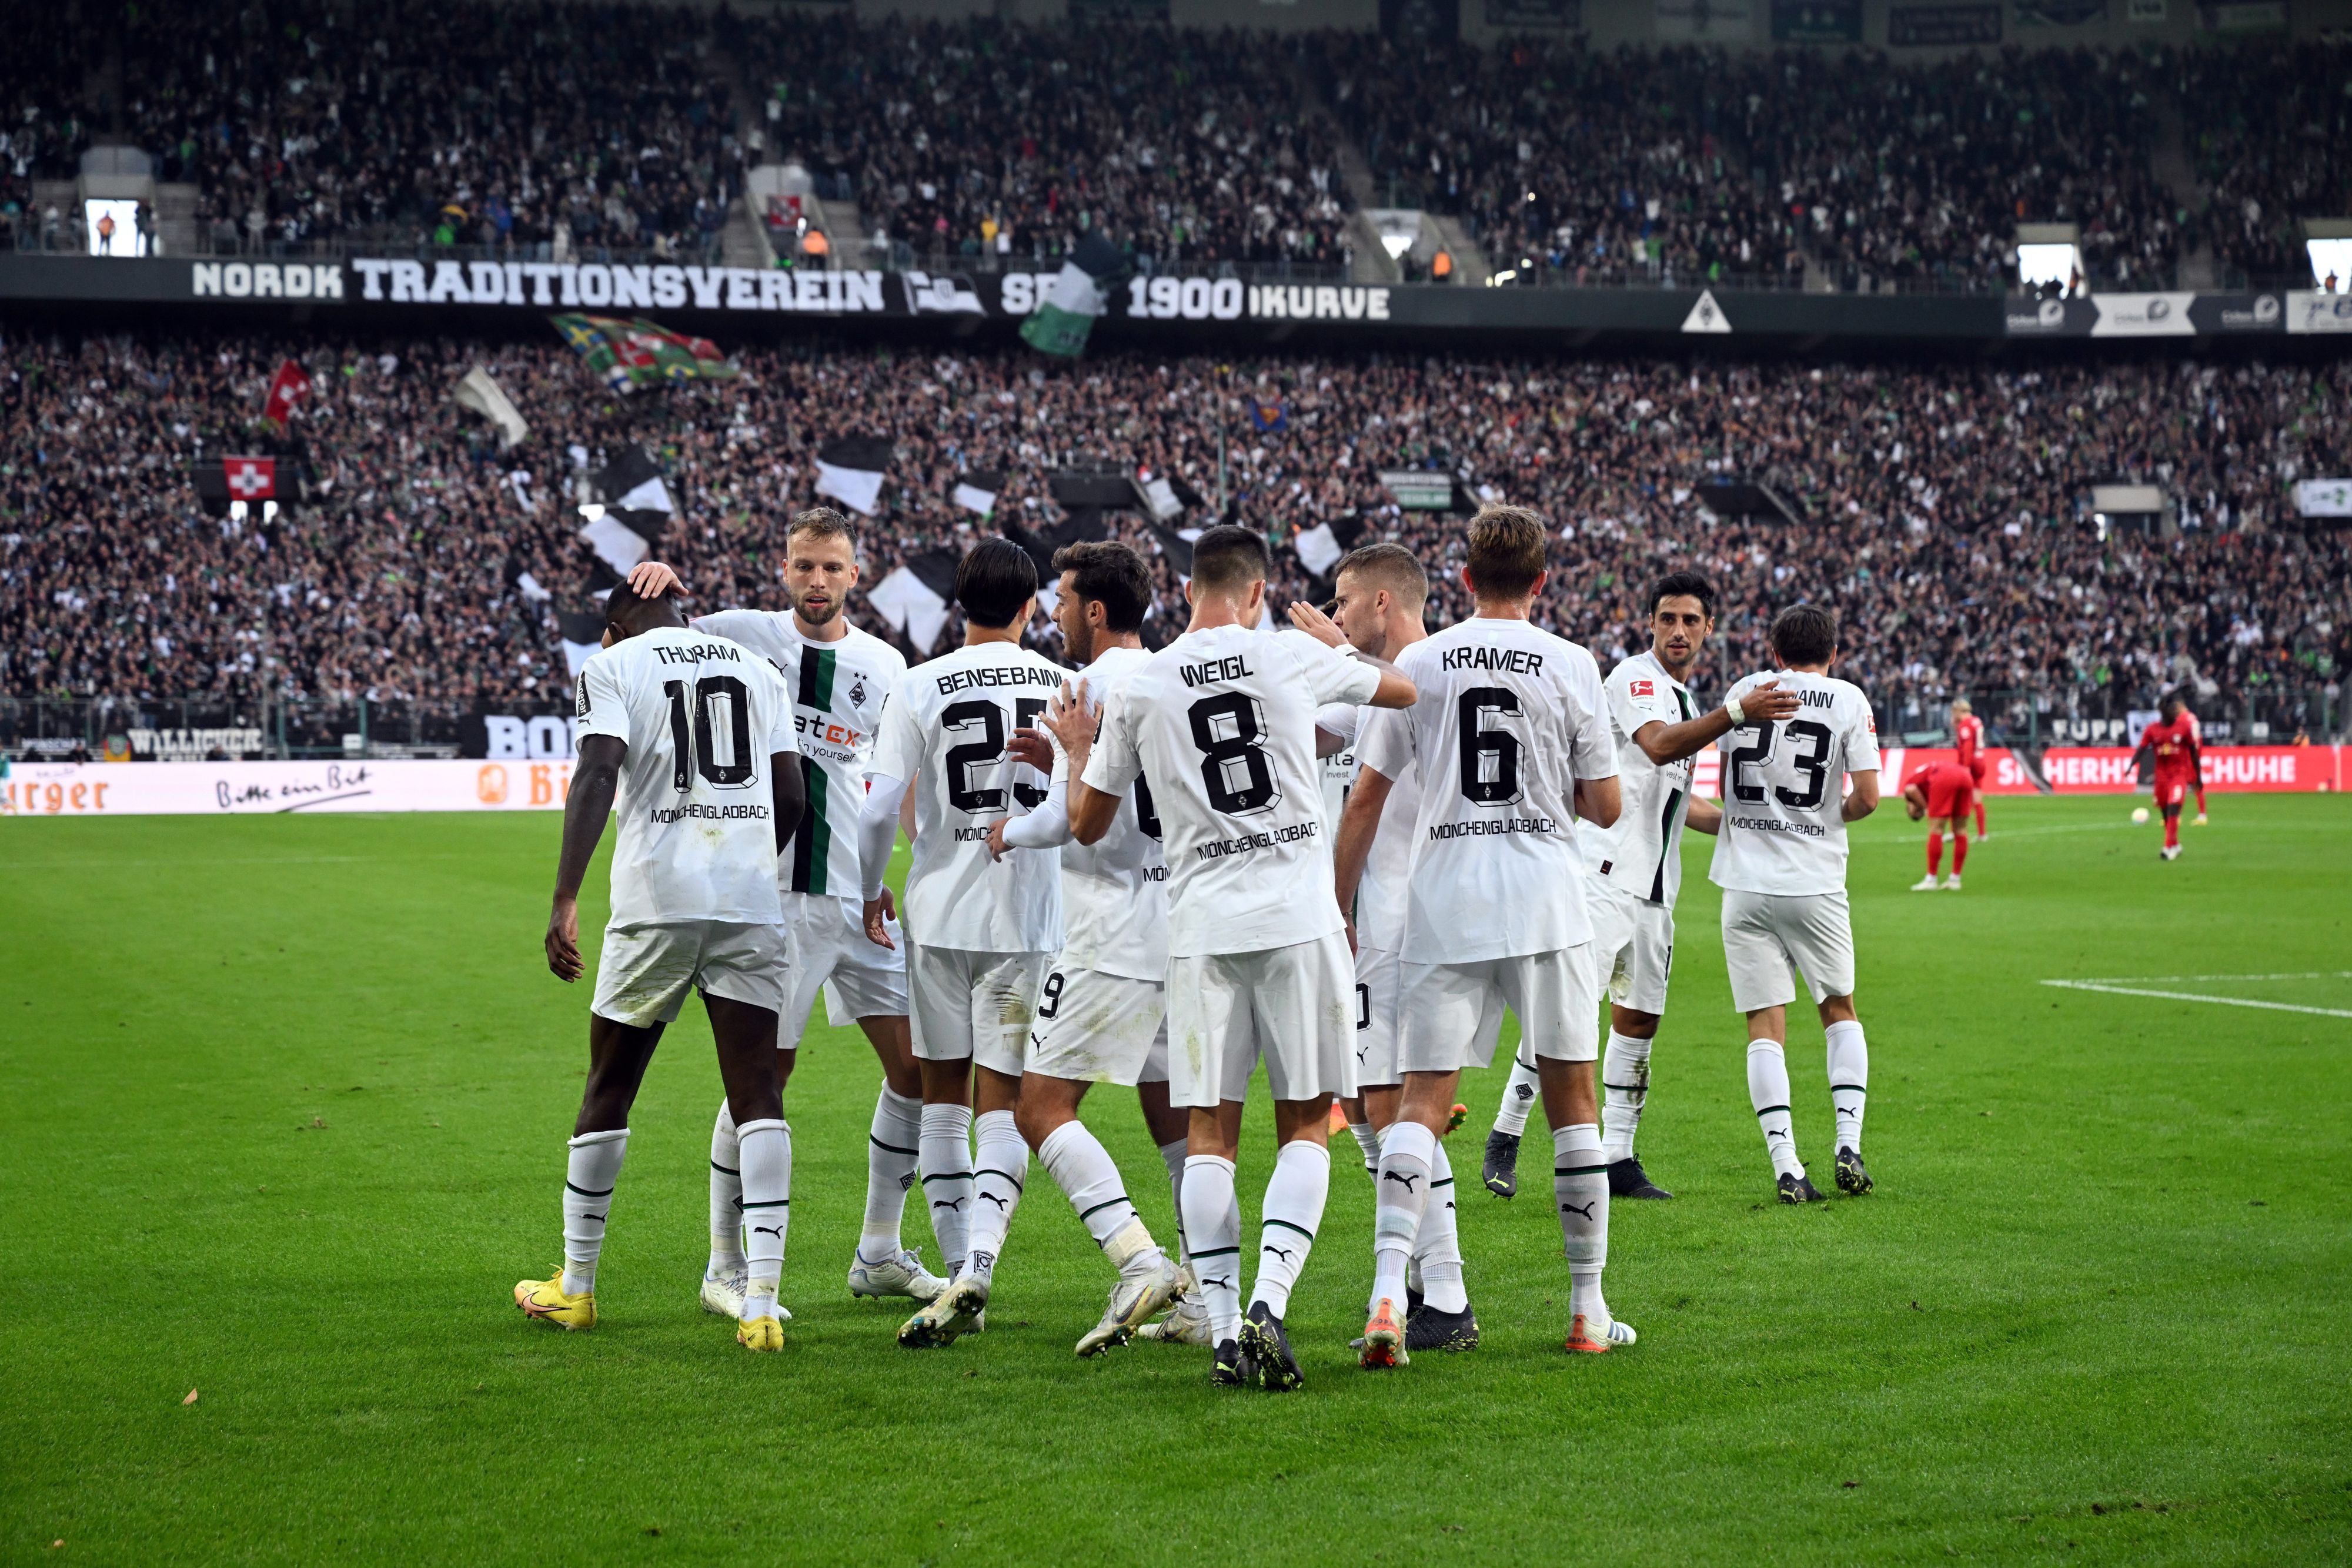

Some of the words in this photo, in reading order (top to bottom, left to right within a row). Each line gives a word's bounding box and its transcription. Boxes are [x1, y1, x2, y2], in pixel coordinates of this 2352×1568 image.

[353, 259, 883, 311] TRADITIONSVEREIN
[1127, 276, 1243, 320] 1900
[1250, 285, 1391, 319] KURVE
[653, 644, 741, 664] THURAM
[1180, 655, 1254, 687] WEIGL
[1442, 647, 1543, 677] KRAMER
[662, 675, 759, 794] 10
[1459, 687, 1525, 807] 6
[813, 745, 856, 763] yourself
[1187, 691, 1282, 817] 8
[1732, 719, 1836, 812] 23
[216, 780, 272, 808] Bitte
[281, 780, 322, 798] ein
[327, 764, 373, 789] Bit
[651, 804, 770, 823] MÖNCHENGLADBACH
[1430, 818, 1557, 840] MÖNCHENGLADBACH
[1730, 816, 1825, 836] MÖNCHENGLADBACH
